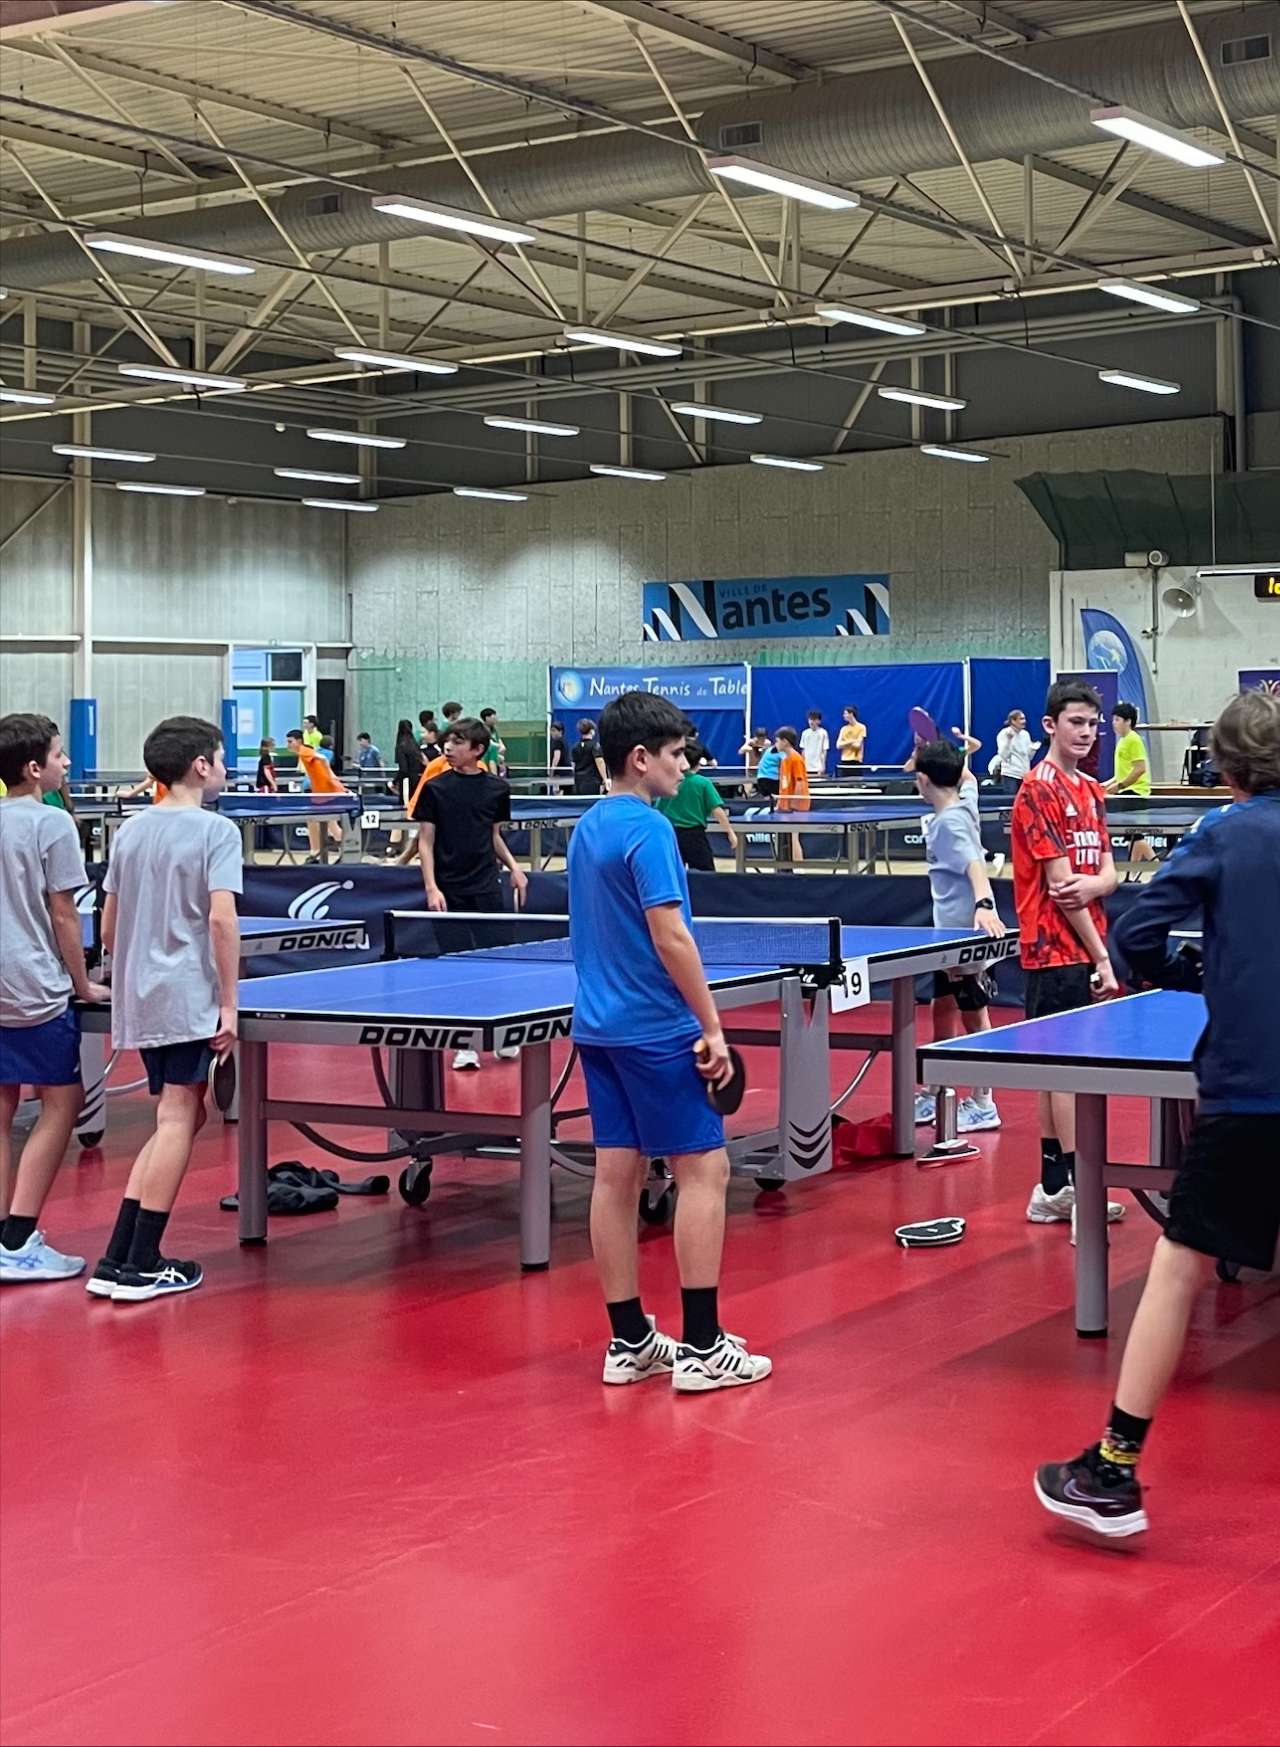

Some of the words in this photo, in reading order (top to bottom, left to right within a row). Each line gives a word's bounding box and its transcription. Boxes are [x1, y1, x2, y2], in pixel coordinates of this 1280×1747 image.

[719, 585, 748, 598] VILLE
[753, 583, 768, 594] DE
[642, 677, 691, 696] Tennis
[365, 814, 376, 824] 12
[279, 930, 358, 951] DONIC
[958, 940, 1018, 964] DONIC
[359, 1025, 474, 1049] DONIC
[502, 1017, 572, 1048] DON
